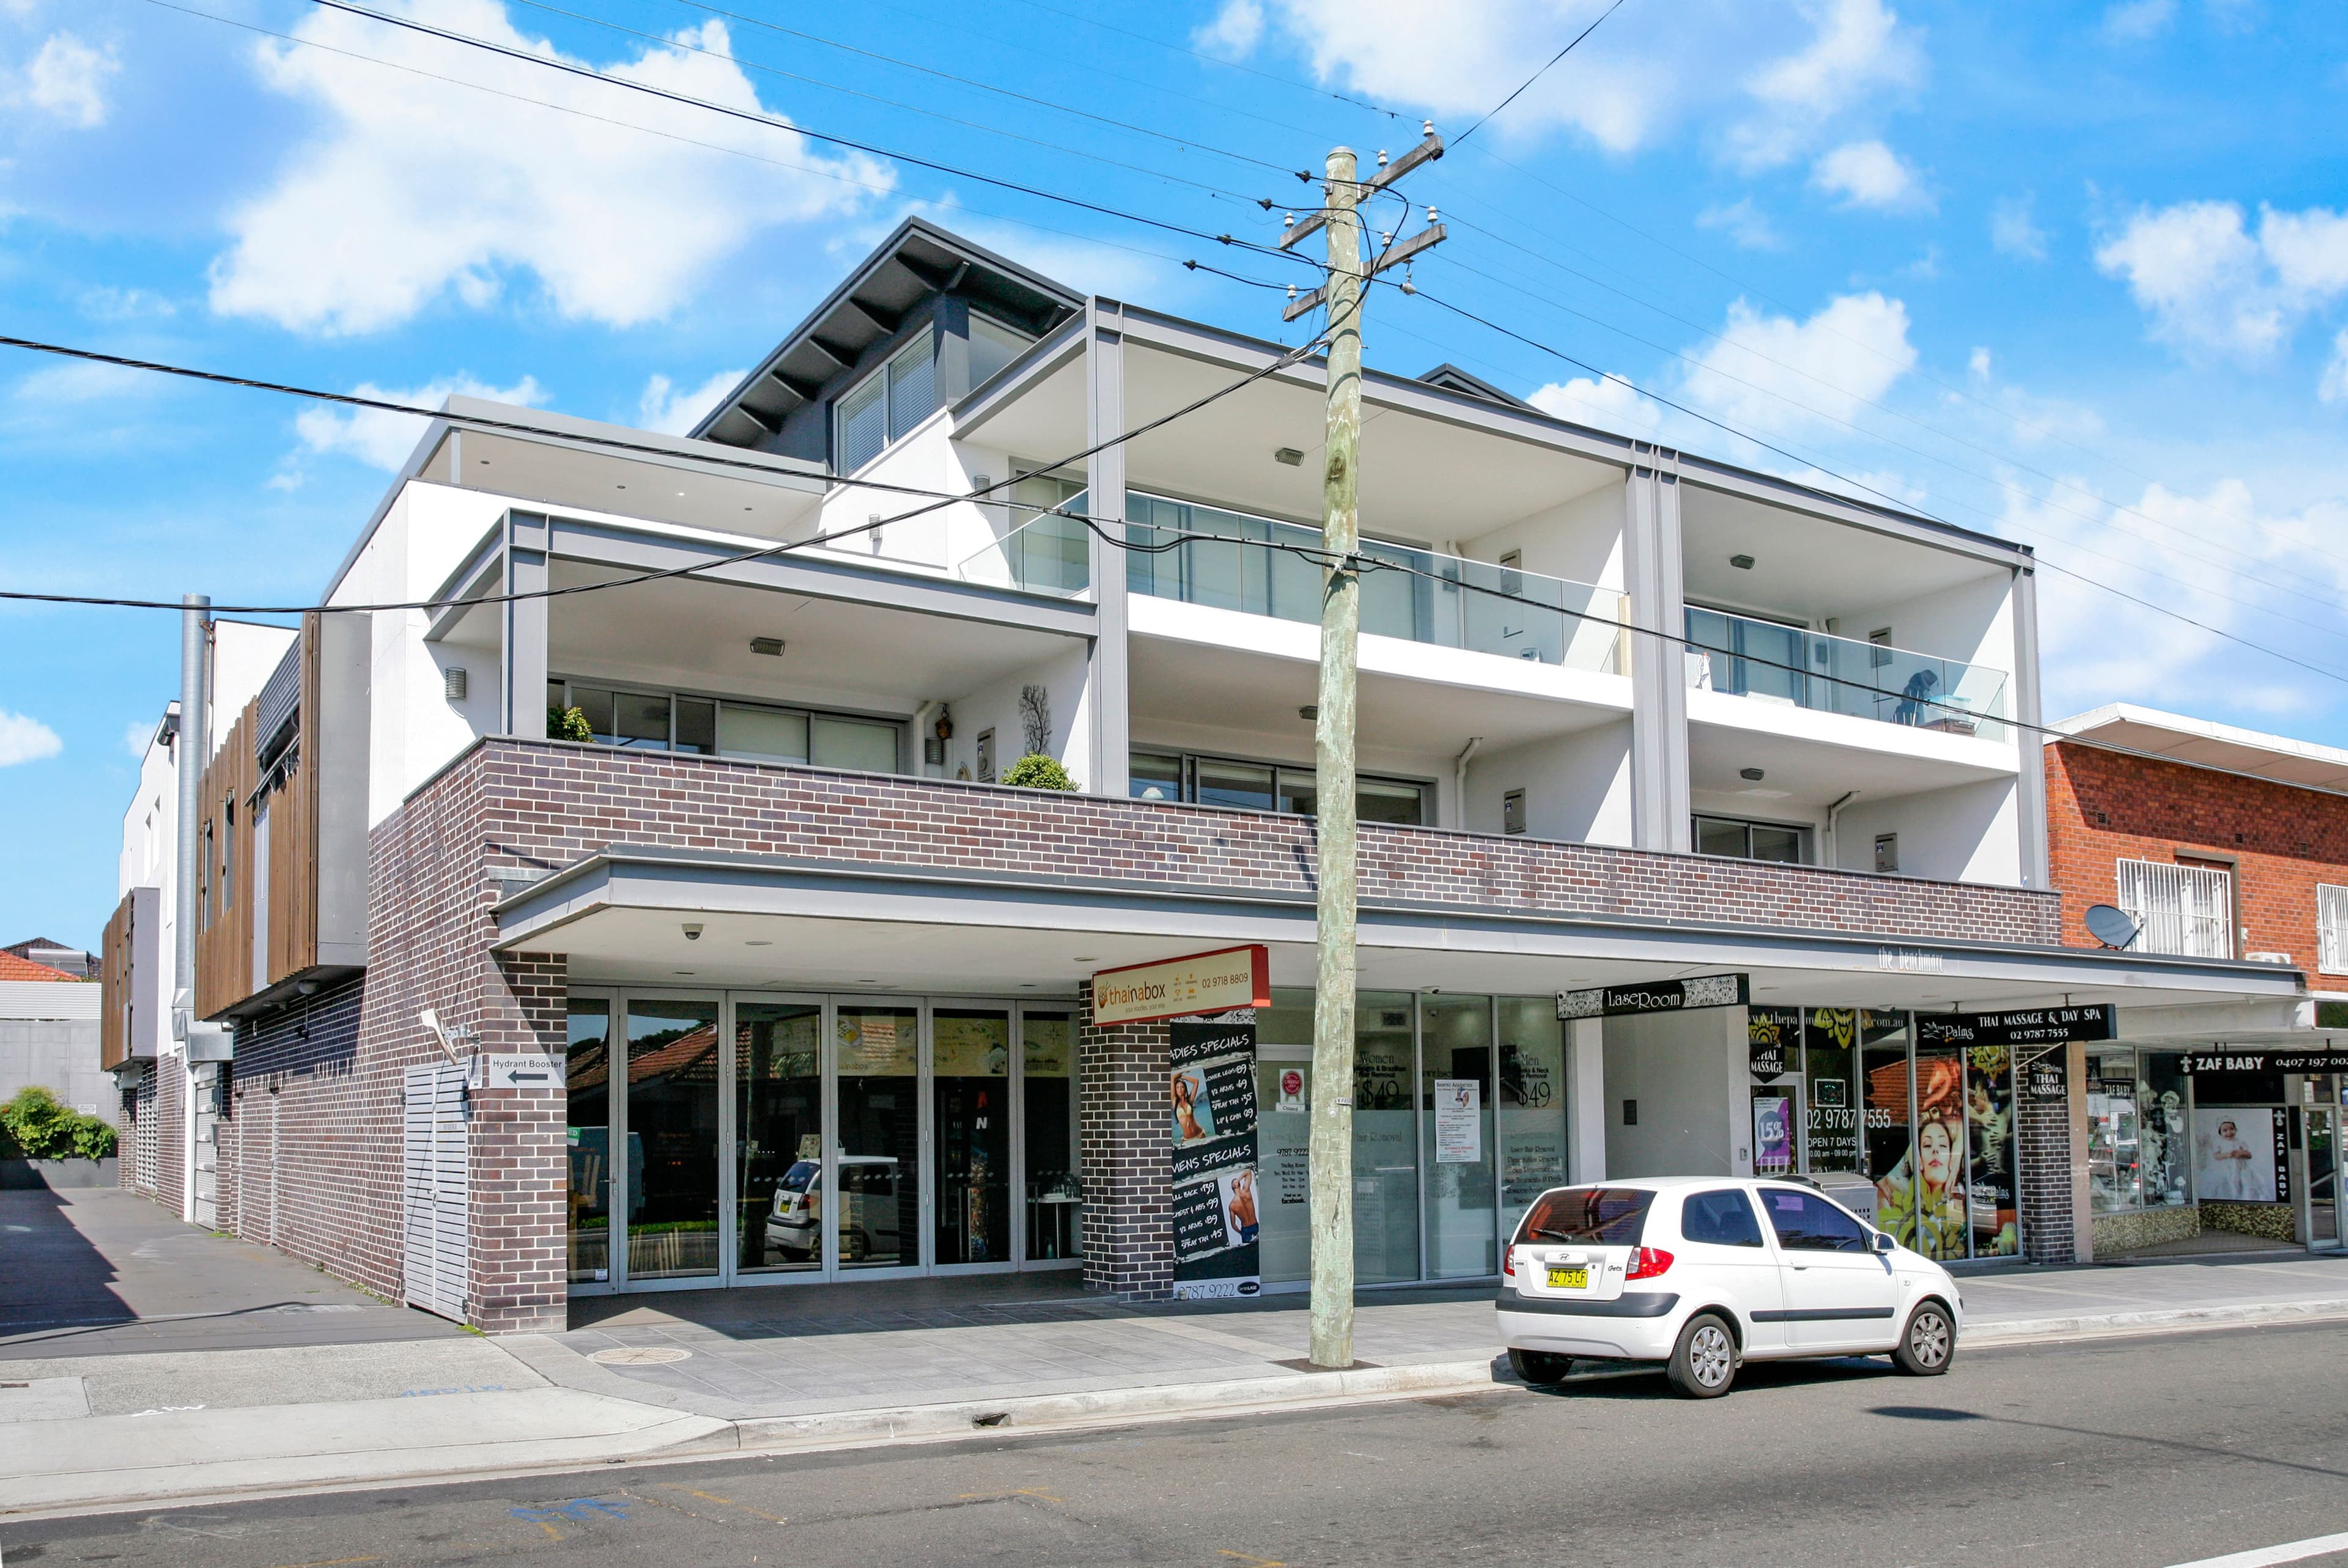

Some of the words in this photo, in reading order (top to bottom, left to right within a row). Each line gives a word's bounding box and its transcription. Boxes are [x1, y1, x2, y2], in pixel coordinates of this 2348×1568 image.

[1878, 945, 1893, 970] the
[1202, 978, 1211, 988] 02
[1213, 976, 1228, 987] 9718
[1230, 973, 1248, 985] 8809
[1110, 981, 1165, 1005] thainabox
[1608, 990, 1680, 1008] LaseRoom
[1978, 1016, 1998, 1028] THAI
[2003, 1013, 2043, 1026] MASSAGE
[2048, 1012, 2058, 1024] &
[2061, 1010, 2079, 1022] DAY
[2084, 1009, 2102, 1020] SPA
[1945, 1025, 1974, 1040] Palms
[2010, 1031, 2021, 1039] 02
[2024, 1029, 2045, 1039] 9787
[2047, 1028, 2069, 1037] 7555
[1170, 1045, 1198, 1060] ADIES
[1200, 1034, 1249, 1054] SPECIALS
[1359, 1051, 1394, 1064] Women
[1757, 1050, 1776, 1061] HAI
[493, 1059, 526, 1069] Hydrant
[529, 1060, 562, 1069] Booster
[1750, 1061, 1783, 1073] MASSAGE
[2196, 1058, 2222, 1070] ZAF
[2226, 1056, 2264, 1070] BABY
[2276, 1058, 2305, 1067] 0407
[2309, 1058, 2327, 1067] 197
[2034, 1073, 2059, 1083] THAI
[1219, 1084, 1234, 1094] ARMS
[1360, 1080, 1400, 1108] $49
[1518, 1081, 1551, 1108] $49
[2030, 1084, 2066, 1095] MASSAGE
[1212, 1101, 1228, 1111] SPRAY
[1807, 1109, 1821, 1129] 02
[1825, 1109, 1856, 1128] 9787
[1863, 1108, 1891, 1128] 7555
[1759, 1122, 1784, 1139] 15%
[1808, 1138, 1828, 1147] OPEN
[1830, 1138, 1834, 1147] 7
[1836, 1137, 1856, 1147] DAYS
[1204, 1144, 1251, 1166] SPECIALS
[1184, 1189, 1198, 1198] BACK
[1188, 1220, 1203, 1230] ARMS
[1181, 1239, 1197, 1250] SPRAY
[1198, 1235, 1209, 1243] TAN
[1548, 1272, 1559, 1283] AZ
[1563, 1272, 1573, 1283] 75
[1576, 1272, 1586, 1283] CF
[1209, 1283, 1235, 1297] 9222
